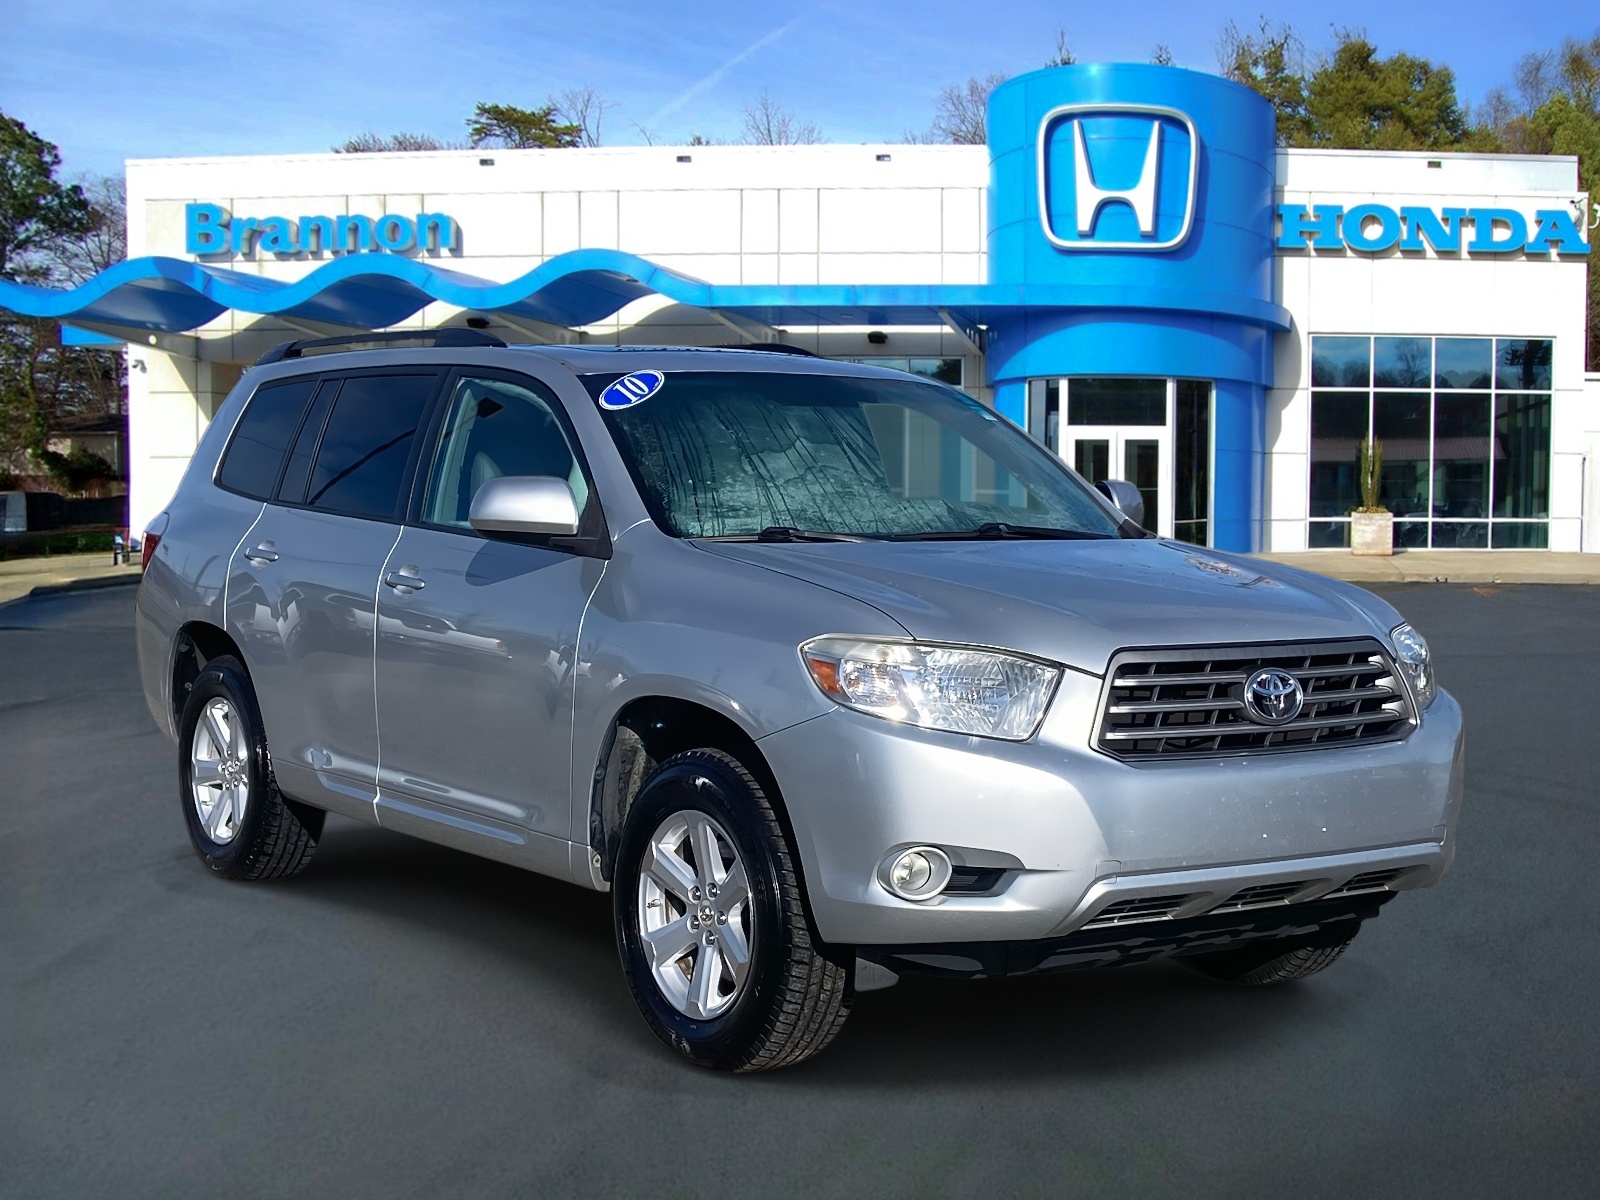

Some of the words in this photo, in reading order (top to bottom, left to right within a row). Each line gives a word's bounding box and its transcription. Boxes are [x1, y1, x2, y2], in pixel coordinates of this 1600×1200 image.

[185, 203, 457, 254] Brannon
[1276, 203, 1591, 255] HONDA
[612, 377, 649, 403] 10
